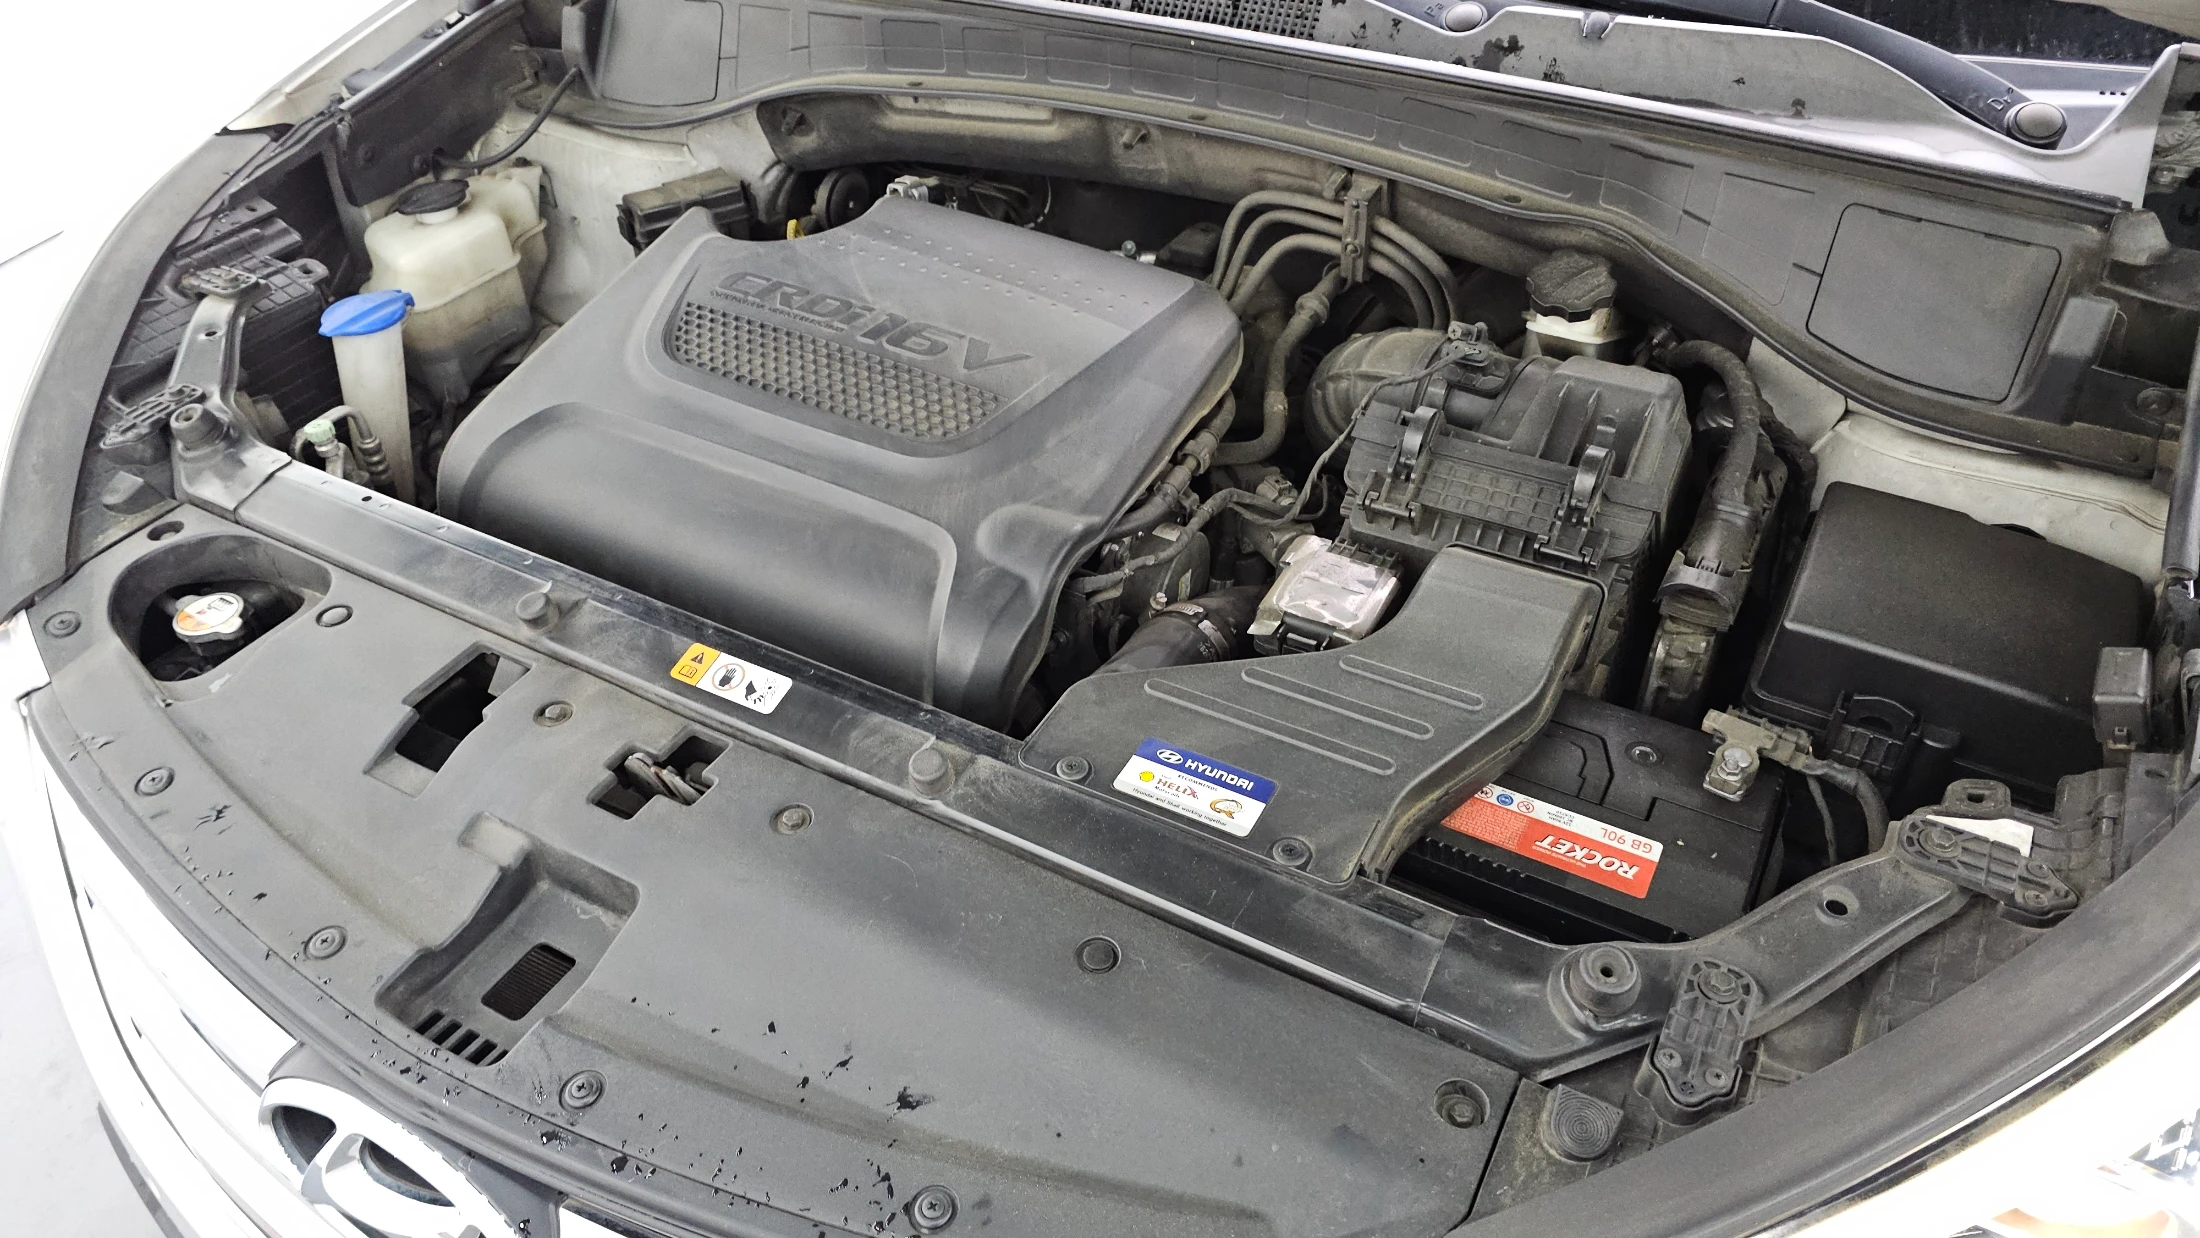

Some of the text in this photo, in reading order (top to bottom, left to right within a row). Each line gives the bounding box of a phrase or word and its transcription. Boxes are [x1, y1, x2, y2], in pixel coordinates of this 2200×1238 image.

[1156, 778, 1198, 799] HELIX
[1185, 758, 1255, 791] HYUNDAI
[1601, 827, 1653, 854] GB 90L
[1533, 833, 1641, 880] ROCKET
